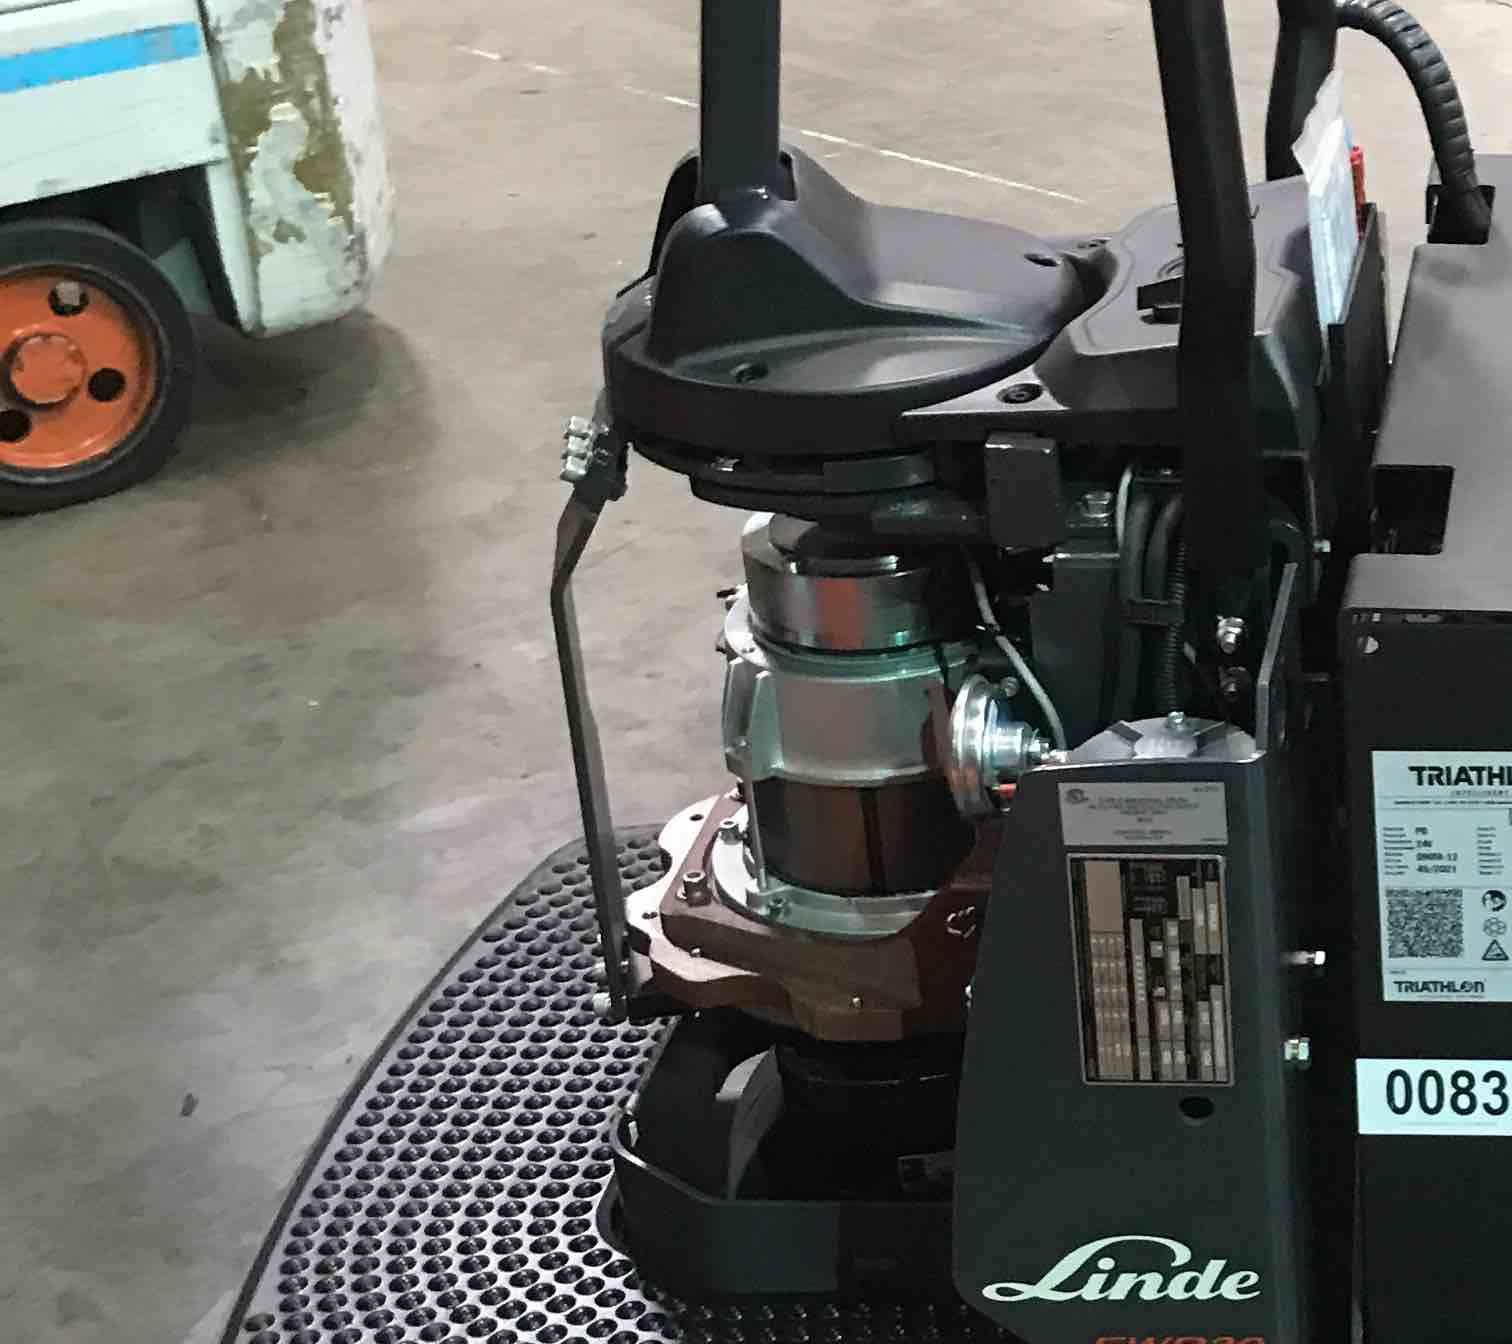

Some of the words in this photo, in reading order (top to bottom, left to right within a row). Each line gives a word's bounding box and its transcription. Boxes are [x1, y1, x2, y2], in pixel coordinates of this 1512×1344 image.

[1393, 981, 1485, 993] TRIATHLON
[1386, 1069, 1510, 1116] 0083
[982, 1235, 1262, 1302] Linde
